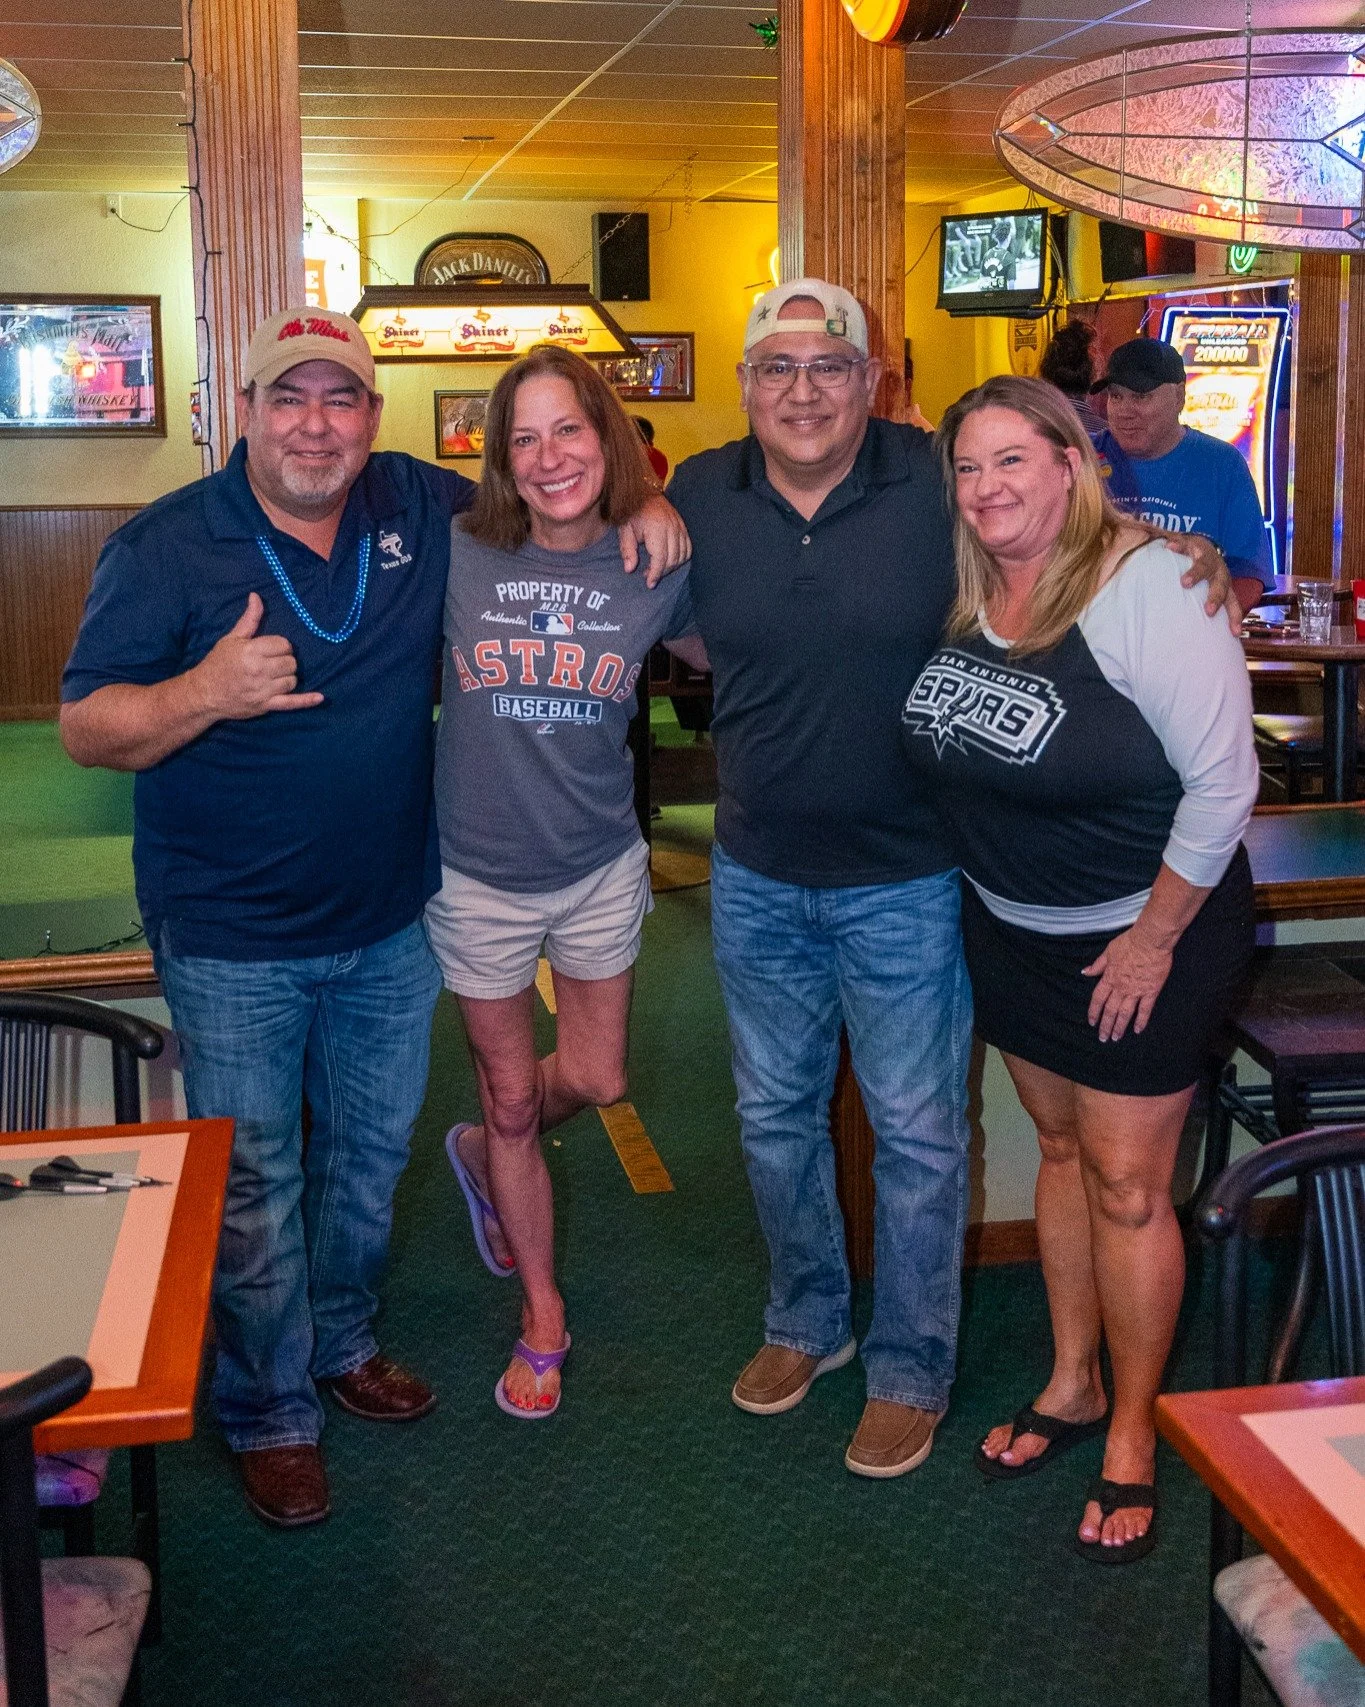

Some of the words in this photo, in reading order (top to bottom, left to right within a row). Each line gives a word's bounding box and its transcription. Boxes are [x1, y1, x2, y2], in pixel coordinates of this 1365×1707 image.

[432, 257, 471, 284] JACK
[473, 252, 531, 284] DANIEL'S
[306, 317, 351, 342] Miss
[77, 393, 139, 407] WHISKEY
[495, 581, 584, 604] PROPERTY
[586, 591, 611, 611] OF
[539, 602, 568, 613] MLB
[481, 611, 528, 626] Authentic
[577, 621, 622, 632] Collection
[452, 638, 642, 703] ASTROS
[940, 655, 967, 669] SAN
[970, 666, 1040, 693] ANTONIO
[498, 697, 598, 719] BASEBALL
[911, 672, 1036, 740] SPURS
